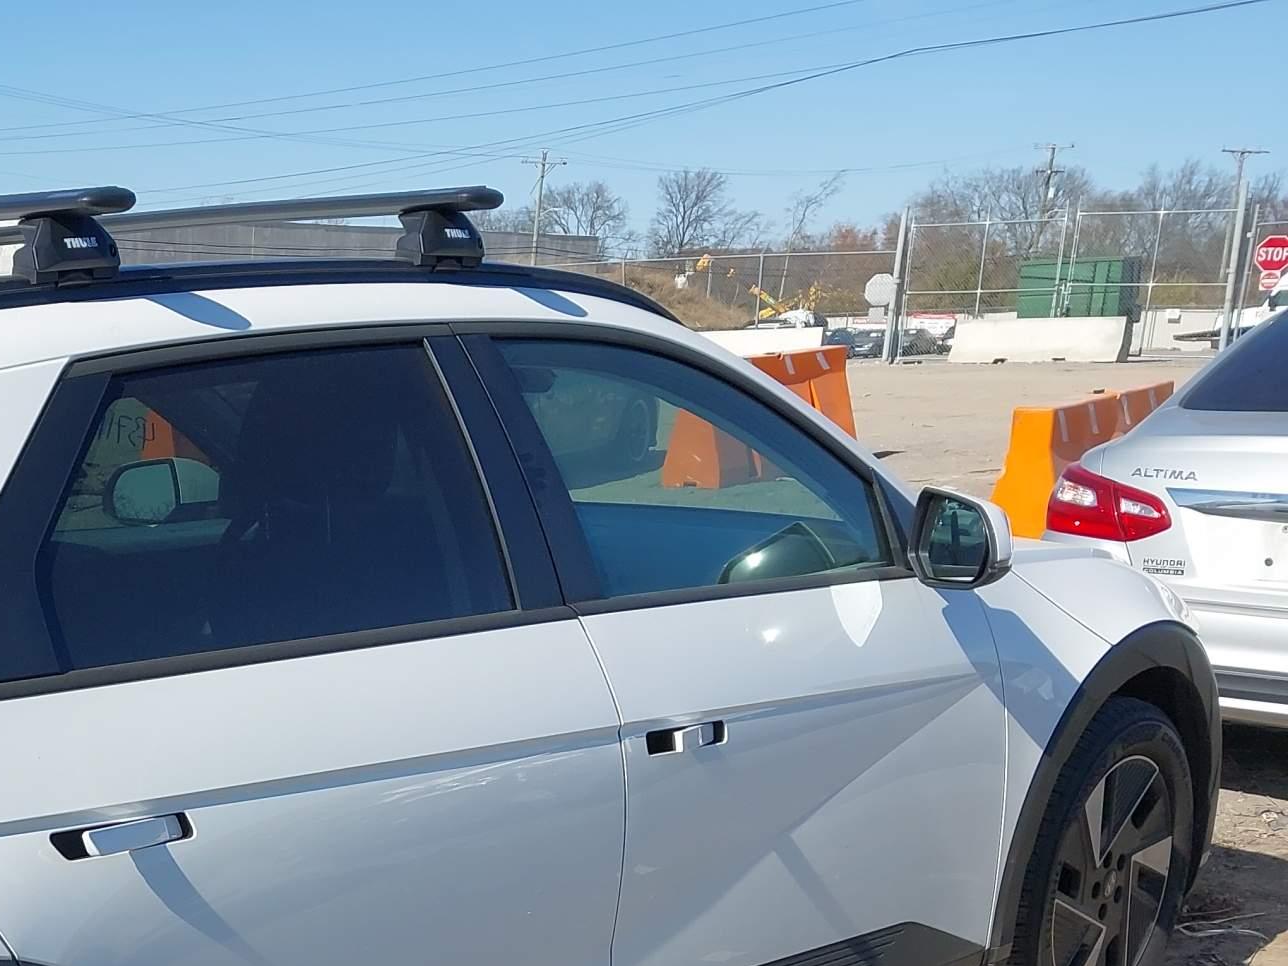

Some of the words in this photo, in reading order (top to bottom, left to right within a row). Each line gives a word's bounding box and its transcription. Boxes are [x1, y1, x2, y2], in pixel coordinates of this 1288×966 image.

[63, 237, 98, 249] THULE
[1131, 467, 1198, 481] ALTIMA
[1143, 557, 1186, 567] HYUNDAI
